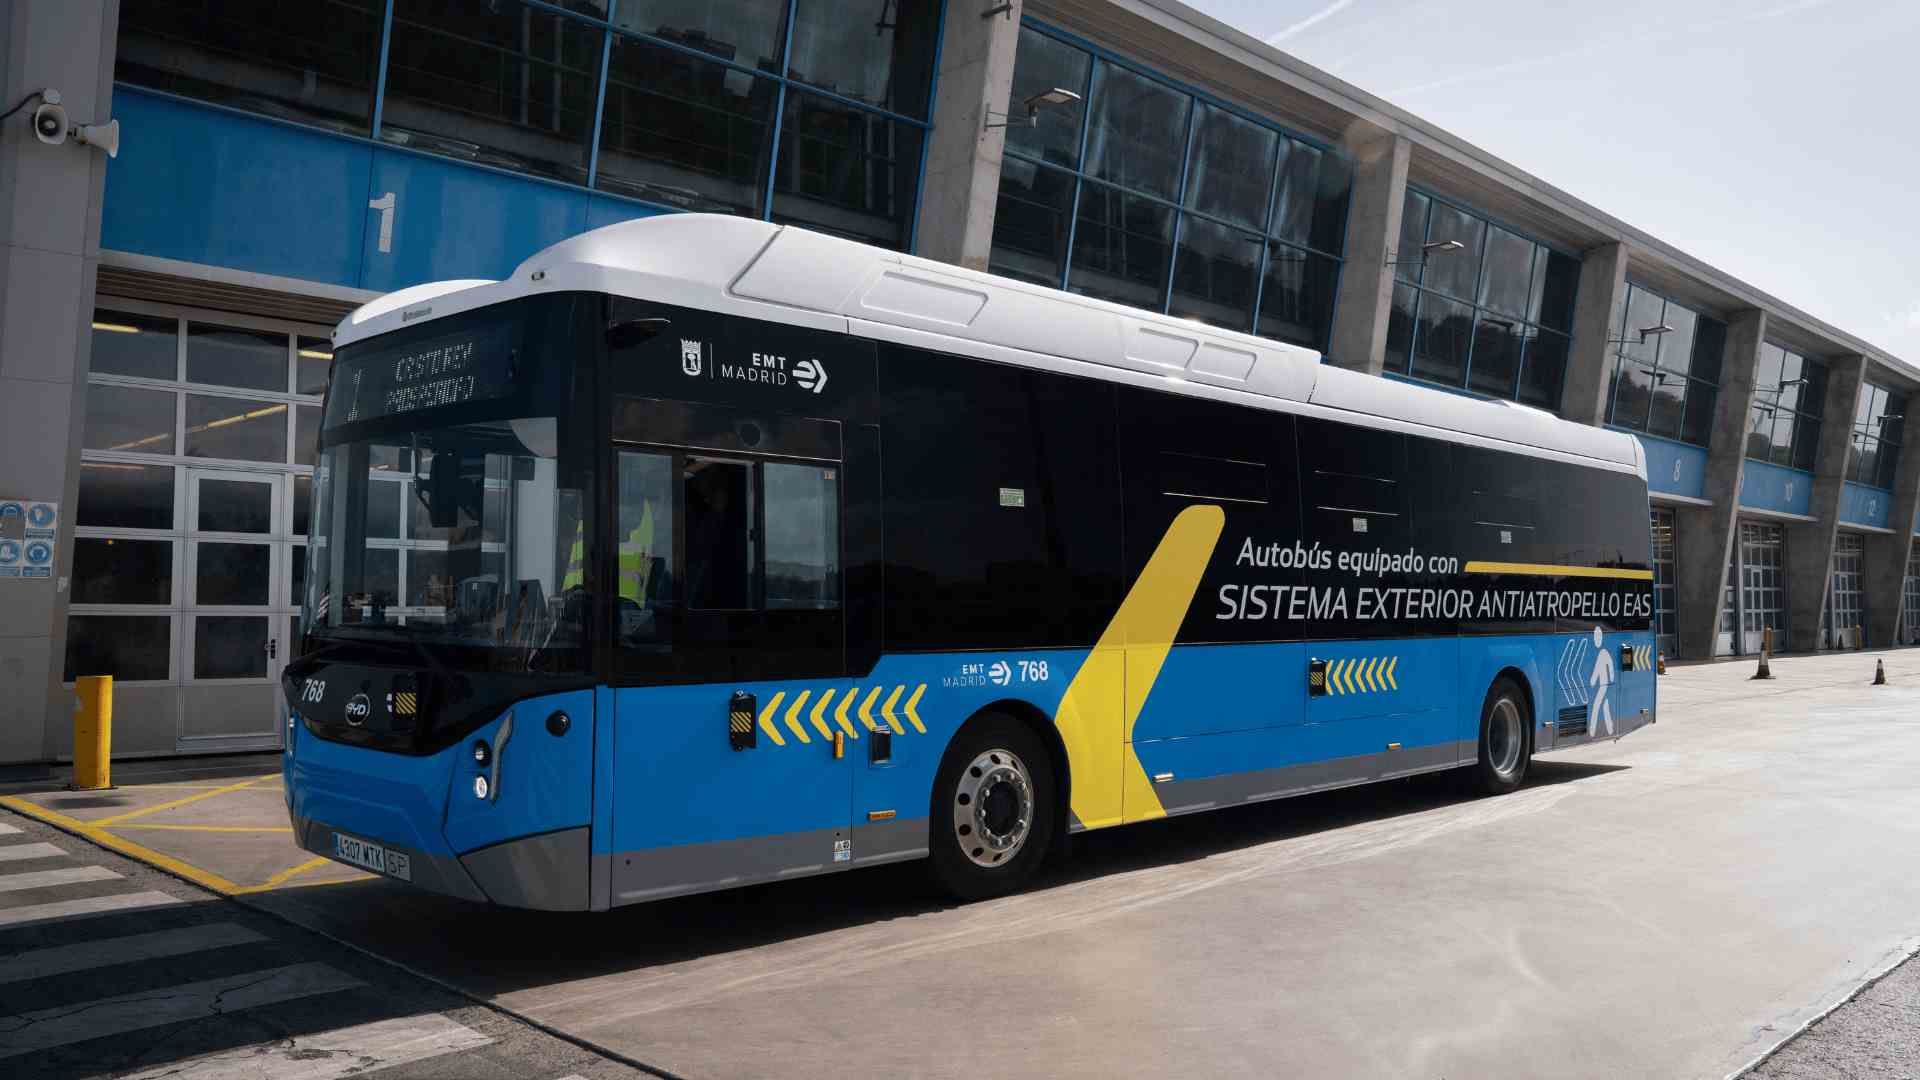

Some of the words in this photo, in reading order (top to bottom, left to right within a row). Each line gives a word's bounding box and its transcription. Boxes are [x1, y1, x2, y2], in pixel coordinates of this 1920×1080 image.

[369, 192, 396, 253] 1
[752, 352, 787, 370] EMT
[721, 365, 786, 385] MADRID
[1235, 536, 1332, 569] Autobús
[1338, 547, 1424, 578] equipado
[1428, 556, 1458, 574] con
[1215, 584, 1349, 620] SISTEMA
[1355, 587, 1474, 619] EXTERIOR
[1476, 589, 1620, 618] ANTIATROPELLO
[1623, 592, 1652, 617] EAS
[962, 663, 985, 675] EMT
[1018, 660, 1049, 682] 768
[302, 678, 326, 703] 768
[943, 675, 986, 688] MADRID
[345, 702, 367, 716] BYD
[388, 852, 408, 874] SP
